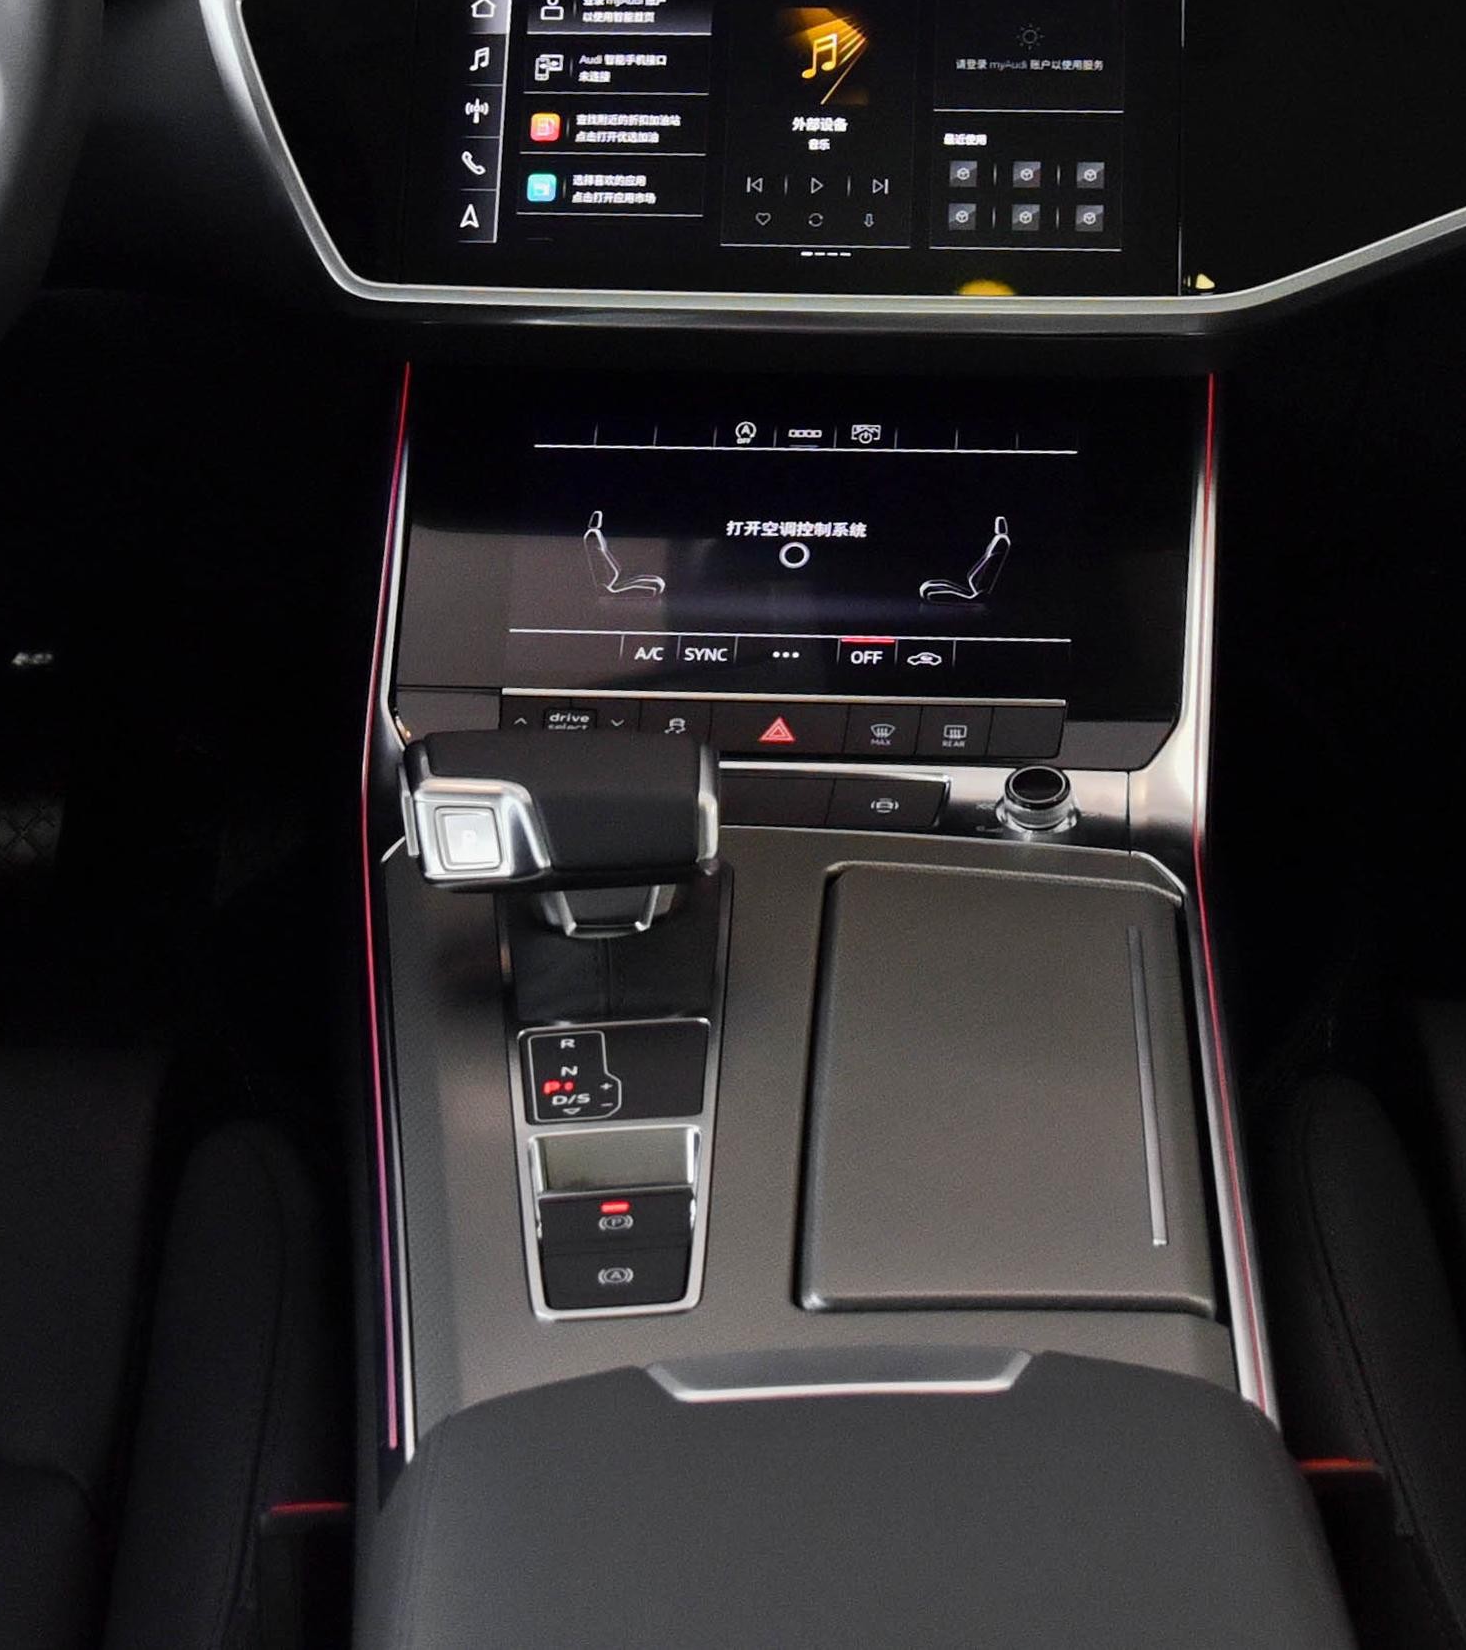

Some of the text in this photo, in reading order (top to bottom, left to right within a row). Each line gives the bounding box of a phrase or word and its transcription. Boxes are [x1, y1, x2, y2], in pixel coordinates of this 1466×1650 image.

[578, 54, 603, 65] Audi
[989, 59, 1028, 71] myAudi
[791, 116, 849, 133] 外部设备
[807, 138, 831, 151] 音乐
[943, 132, 988, 147] 最近使用
[736, 437, 752, 445] OFF
[725, 519, 868, 538] 打开空调控制系统
[634, 647, 664, 661] A/C
[684, 648, 728, 662] SYNC
[850, 650, 883, 665] OFF
[548, 712, 590, 723] drive
[870, 738, 892, 746] MAX
[941, 740, 966, 748] REAR
[560, 1038, 575, 1049] R
[560, 1065, 578, 1077] N
[543, 1080, 561, 1094] P
[552, 1093, 591, 1105] D/S
